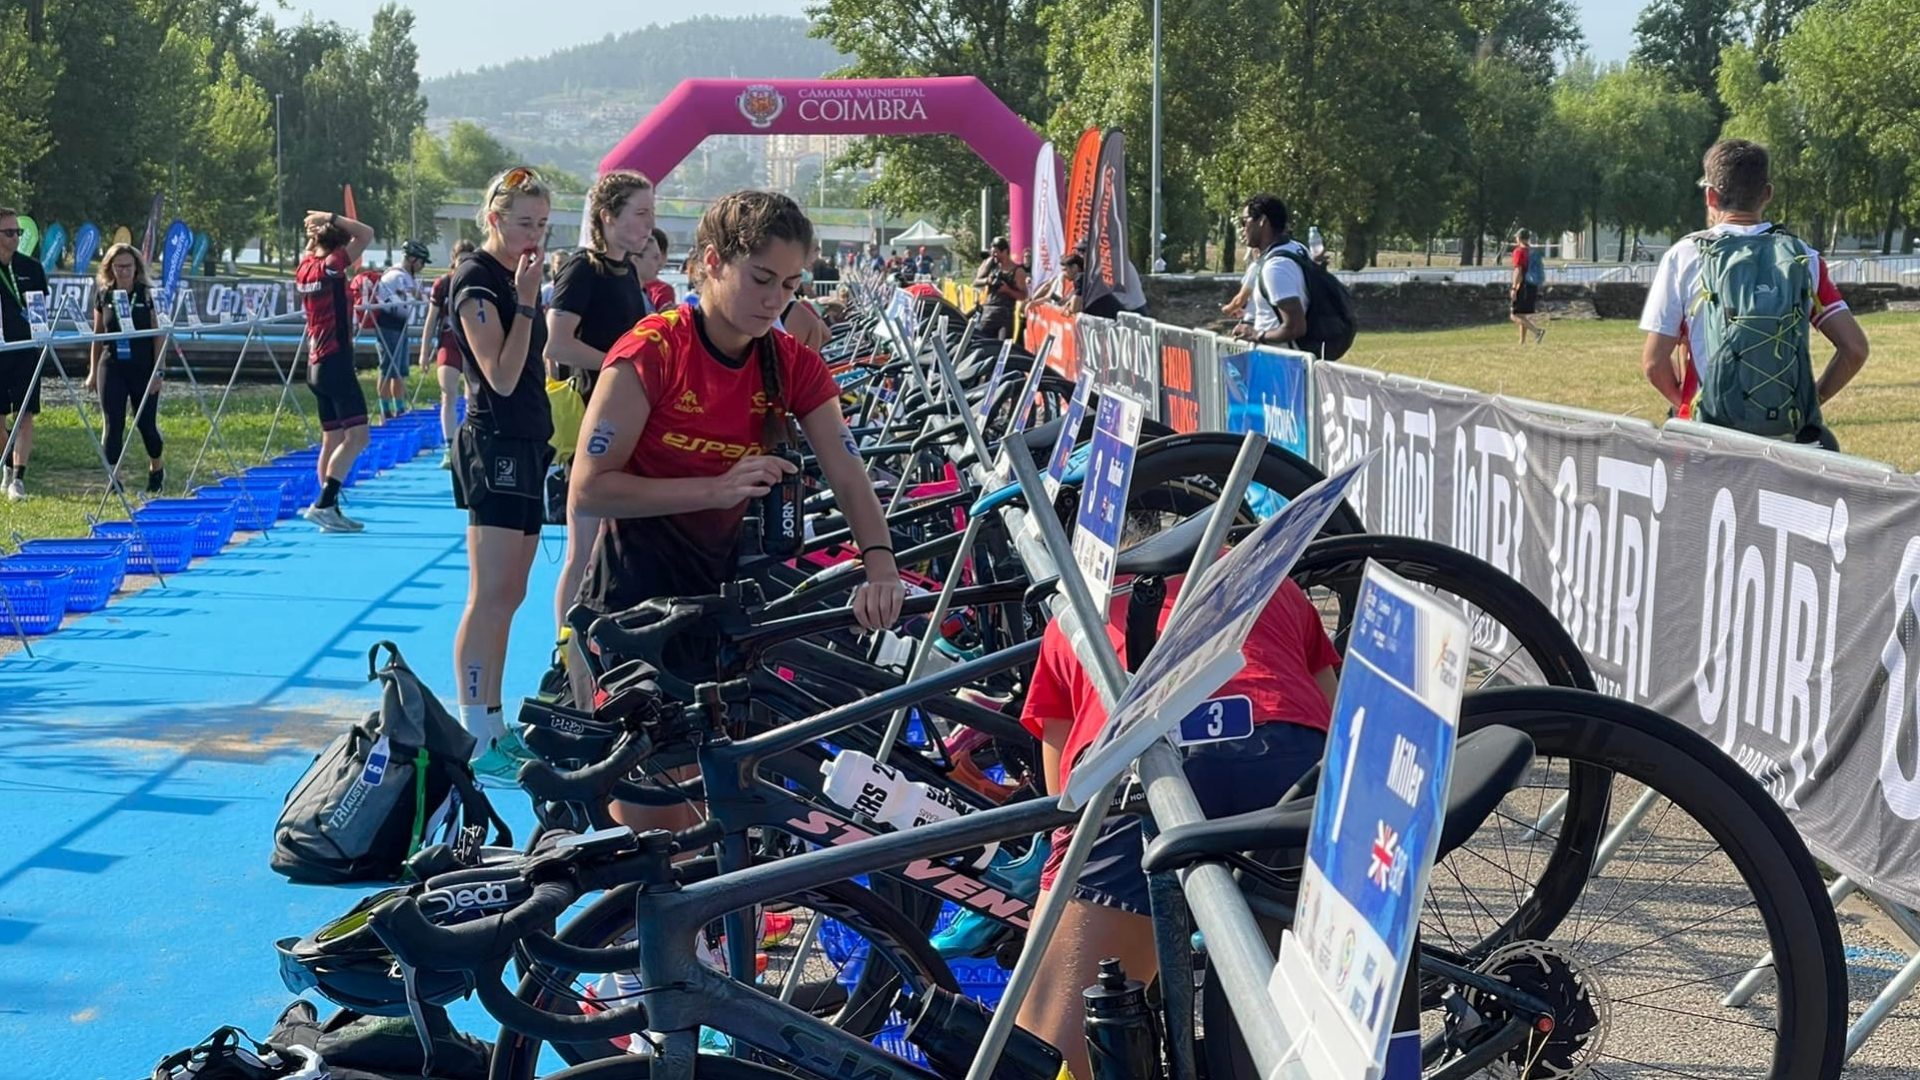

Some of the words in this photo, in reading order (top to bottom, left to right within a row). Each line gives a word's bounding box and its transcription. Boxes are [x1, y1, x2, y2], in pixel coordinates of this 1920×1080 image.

[798, 99, 928, 121] COIMBRA
[856, 87, 925, 98] MUNICIPAL
[587, 435, 609, 454] 6
[1087, 449, 1103, 514] 3
[1207, 701, 1223, 736] 3
[1331, 706, 1366, 843] 1
[1386, 733, 1424, 808] Miller
